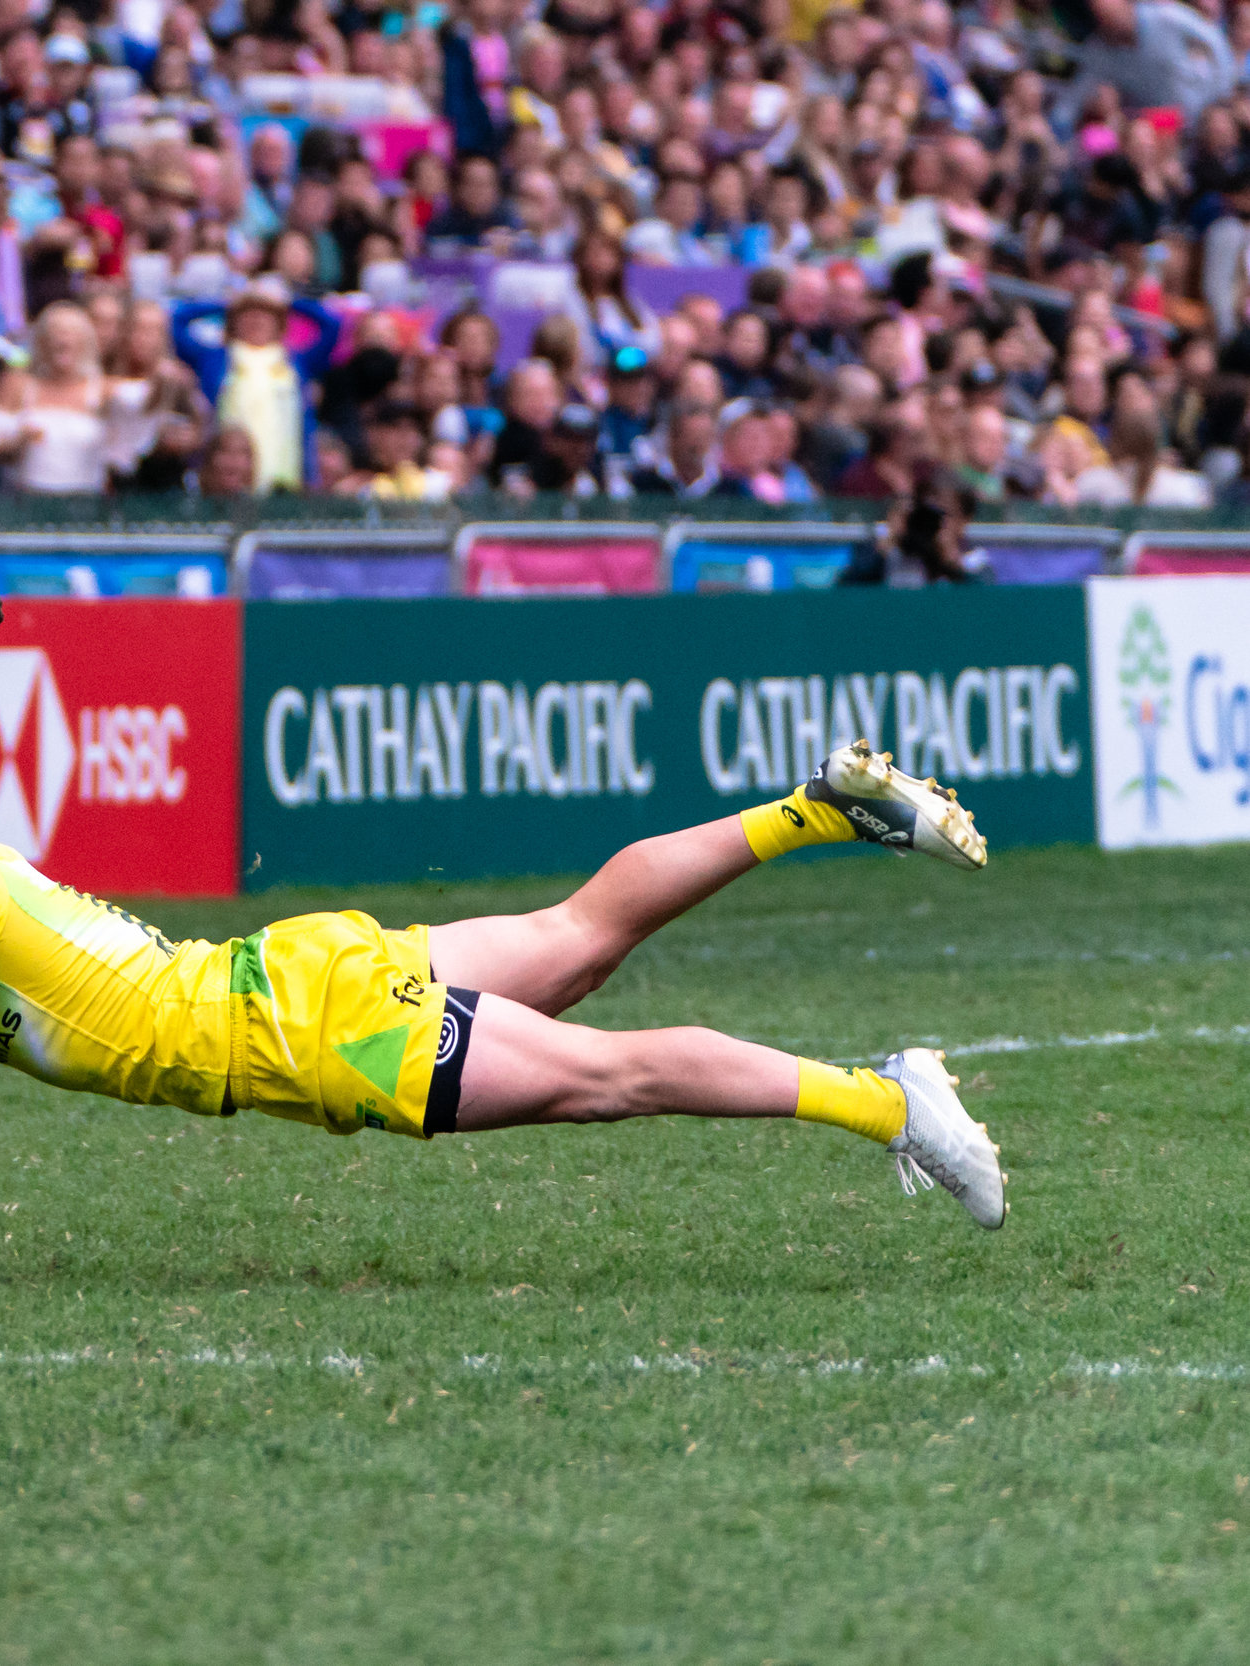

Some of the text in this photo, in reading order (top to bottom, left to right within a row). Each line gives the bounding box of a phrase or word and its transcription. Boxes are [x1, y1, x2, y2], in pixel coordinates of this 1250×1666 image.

[79, 704, 189, 803] HSBC
[263, 678, 656, 808] CATHAY PACIFIC
[701, 661, 1081, 795] CATHAY PACIFIC
[846, 804, 891, 835] asics
